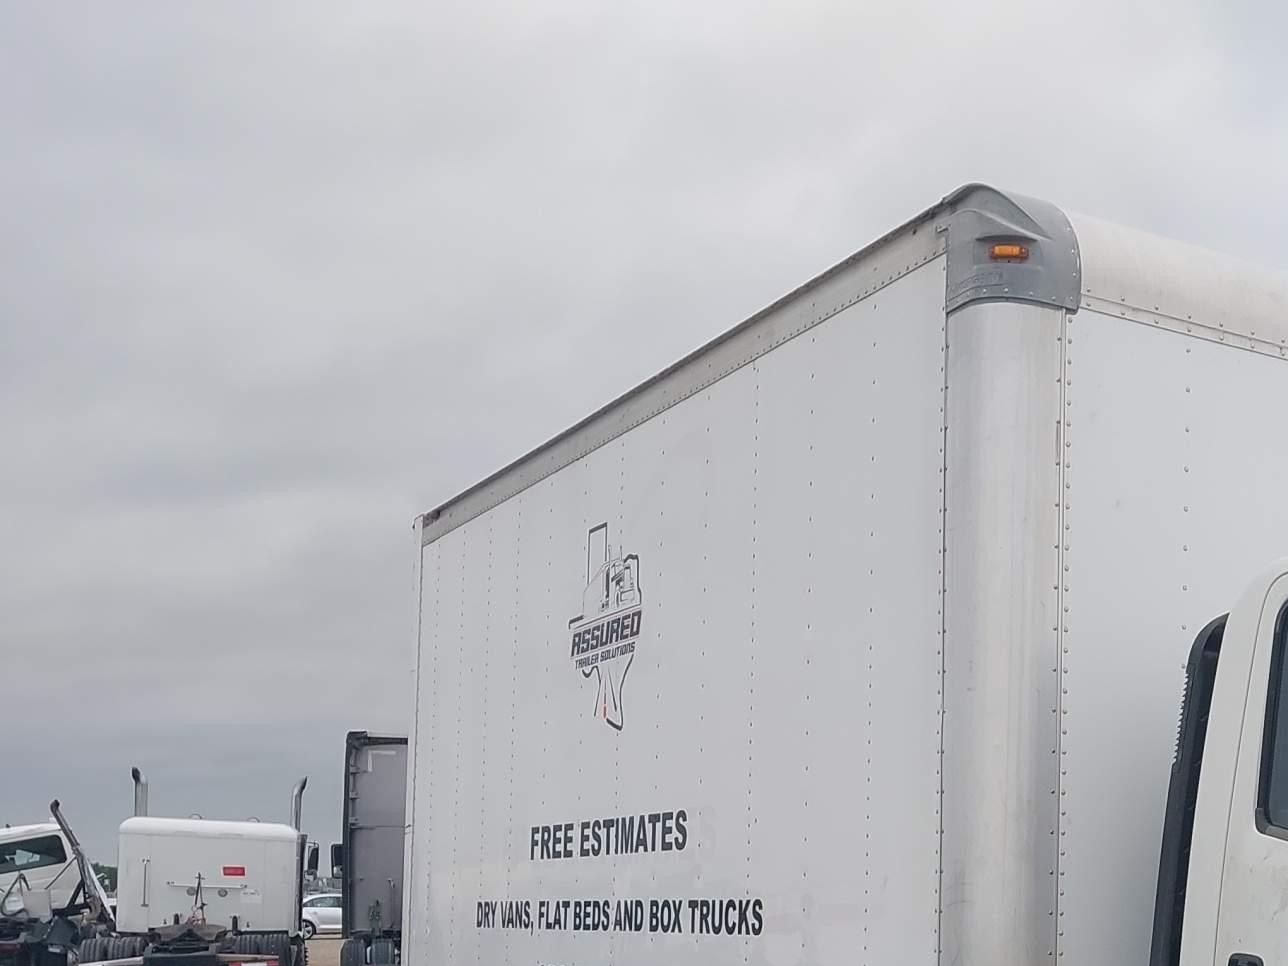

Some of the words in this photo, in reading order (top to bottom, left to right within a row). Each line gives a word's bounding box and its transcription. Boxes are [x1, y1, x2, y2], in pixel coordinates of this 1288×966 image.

[570, 610, 642, 657] ASSURED
[575, 652, 600, 670] TRAILER
[600, 641, 636, 662] SOLUTIONS
[530, 823, 574, 861] FREE
[579, 809, 688, 857] ESTIMATES
[476, 901, 498, 929] DRY
[500, 900, 534, 936] VANS,
[538, 900, 571, 931] FLAT
[573, 899, 610, 931] BEDS
[613, 899, 644, 932] AND
[649, 899, 683, 933] BOX
[688, 898, 763, 936] TRUCKS
